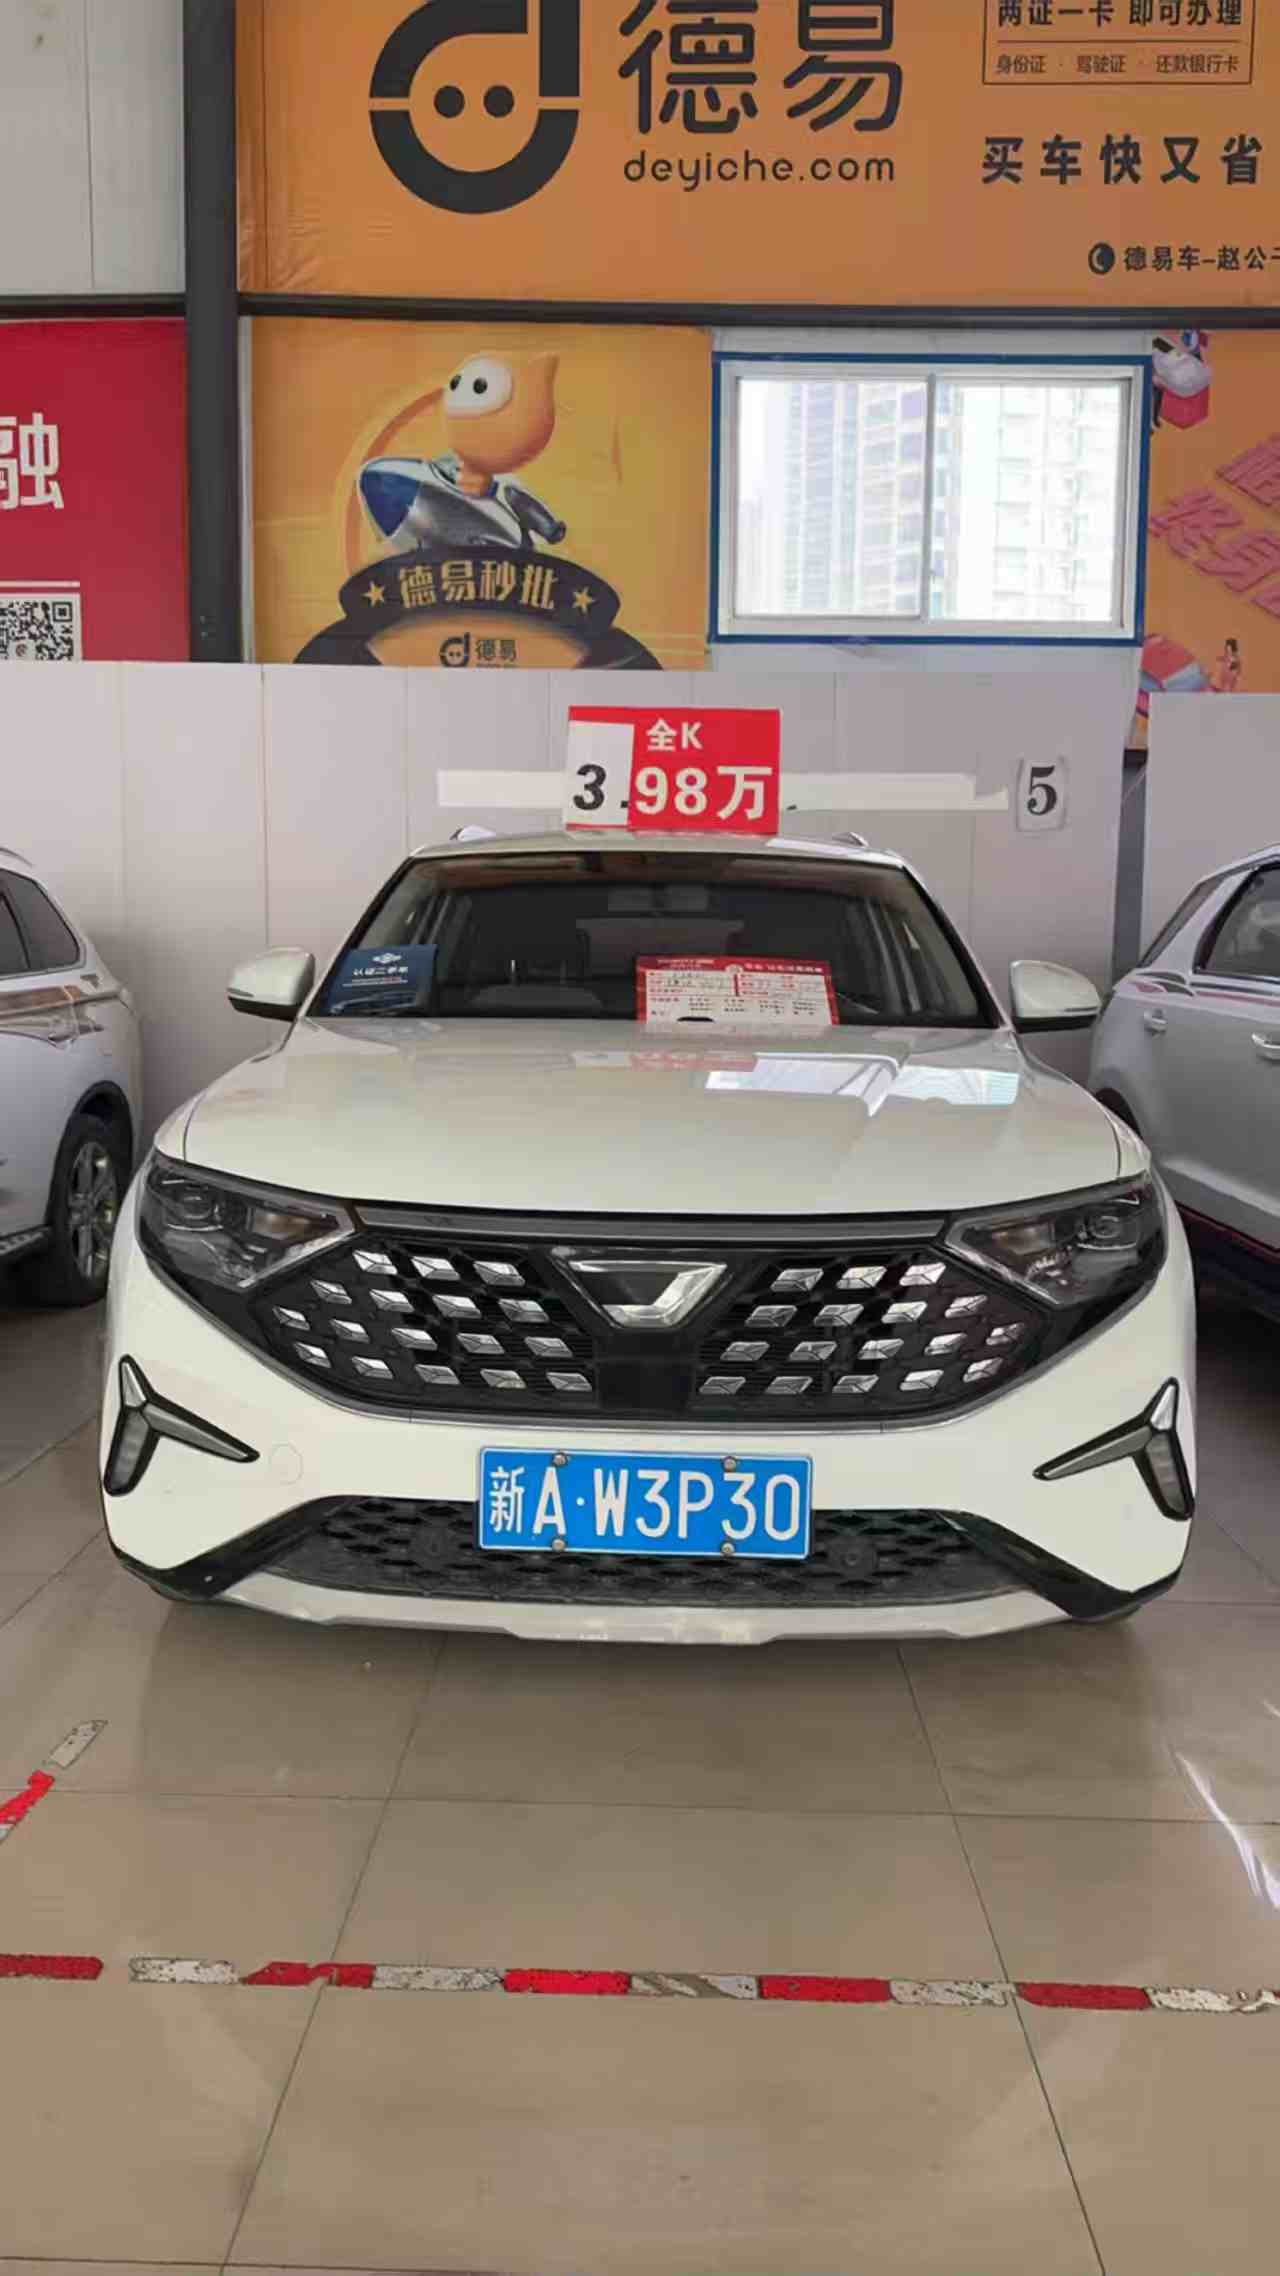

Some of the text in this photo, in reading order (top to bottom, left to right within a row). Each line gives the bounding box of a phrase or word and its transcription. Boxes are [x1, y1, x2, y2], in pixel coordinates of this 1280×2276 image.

[997, 0, 1242, 27] 两证一卡 即可办理
[618, 0, 903, 134] 德易
[996, 54, 1048, 74] 身份证
[1155, 54, 1240, 74] 还款银行卡
[623, 151, 895, 192] deyiche.com
[981, 133, 1263, 185] 买车快又省
[398, 560, 558, 612] 德易秒批
[646, 718, 703, 752] 全K
[1027, 766, 1058, 816] 5
[489, 1465, 800, 1541] 新A·W3P30
